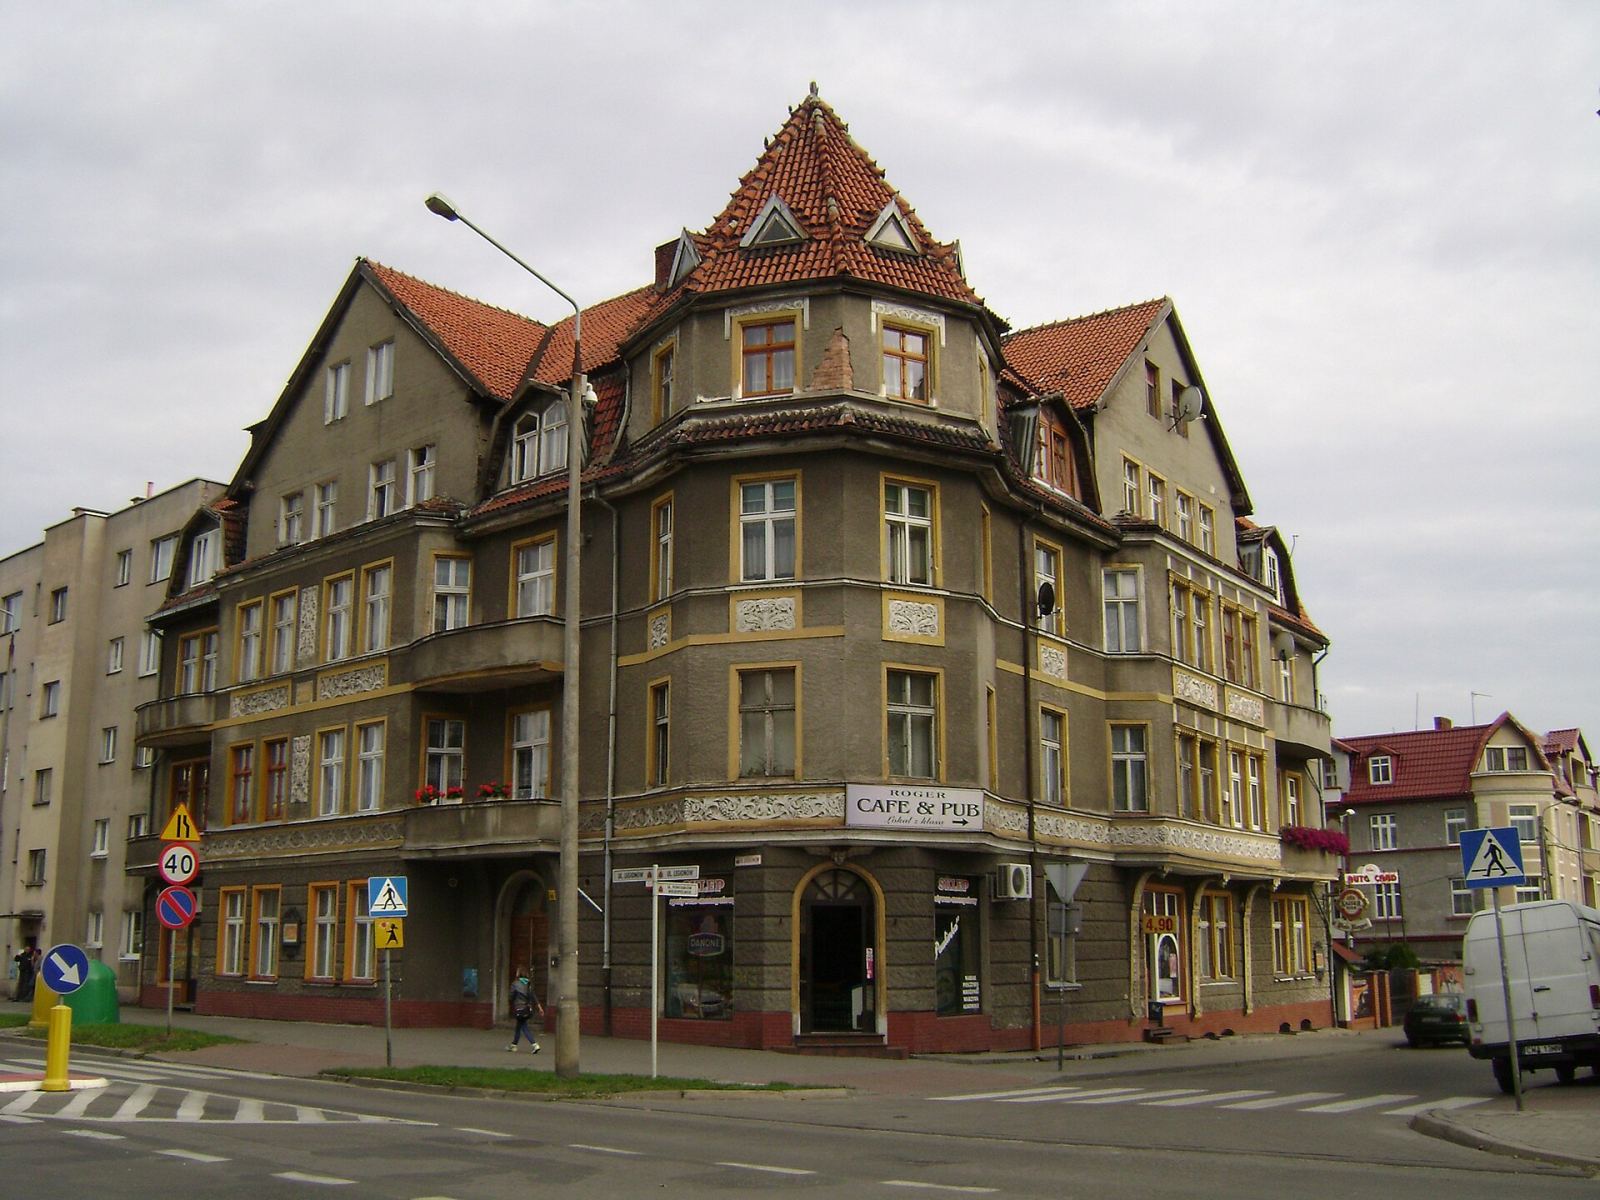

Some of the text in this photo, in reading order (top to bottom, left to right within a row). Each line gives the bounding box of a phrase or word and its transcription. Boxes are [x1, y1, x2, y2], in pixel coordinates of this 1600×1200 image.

[890, 789, 946, 798] ROGER
[857, 798, 980, 817] CAFE & PUB
[165, 854, 192, 874] 40
[938, 878, 969, 892] SKLEP
[1347, 875, 1370, 883] AUTO
[1146, 918, 1173, 931] 4.90
[690, 938, 720, 947] DANONE
